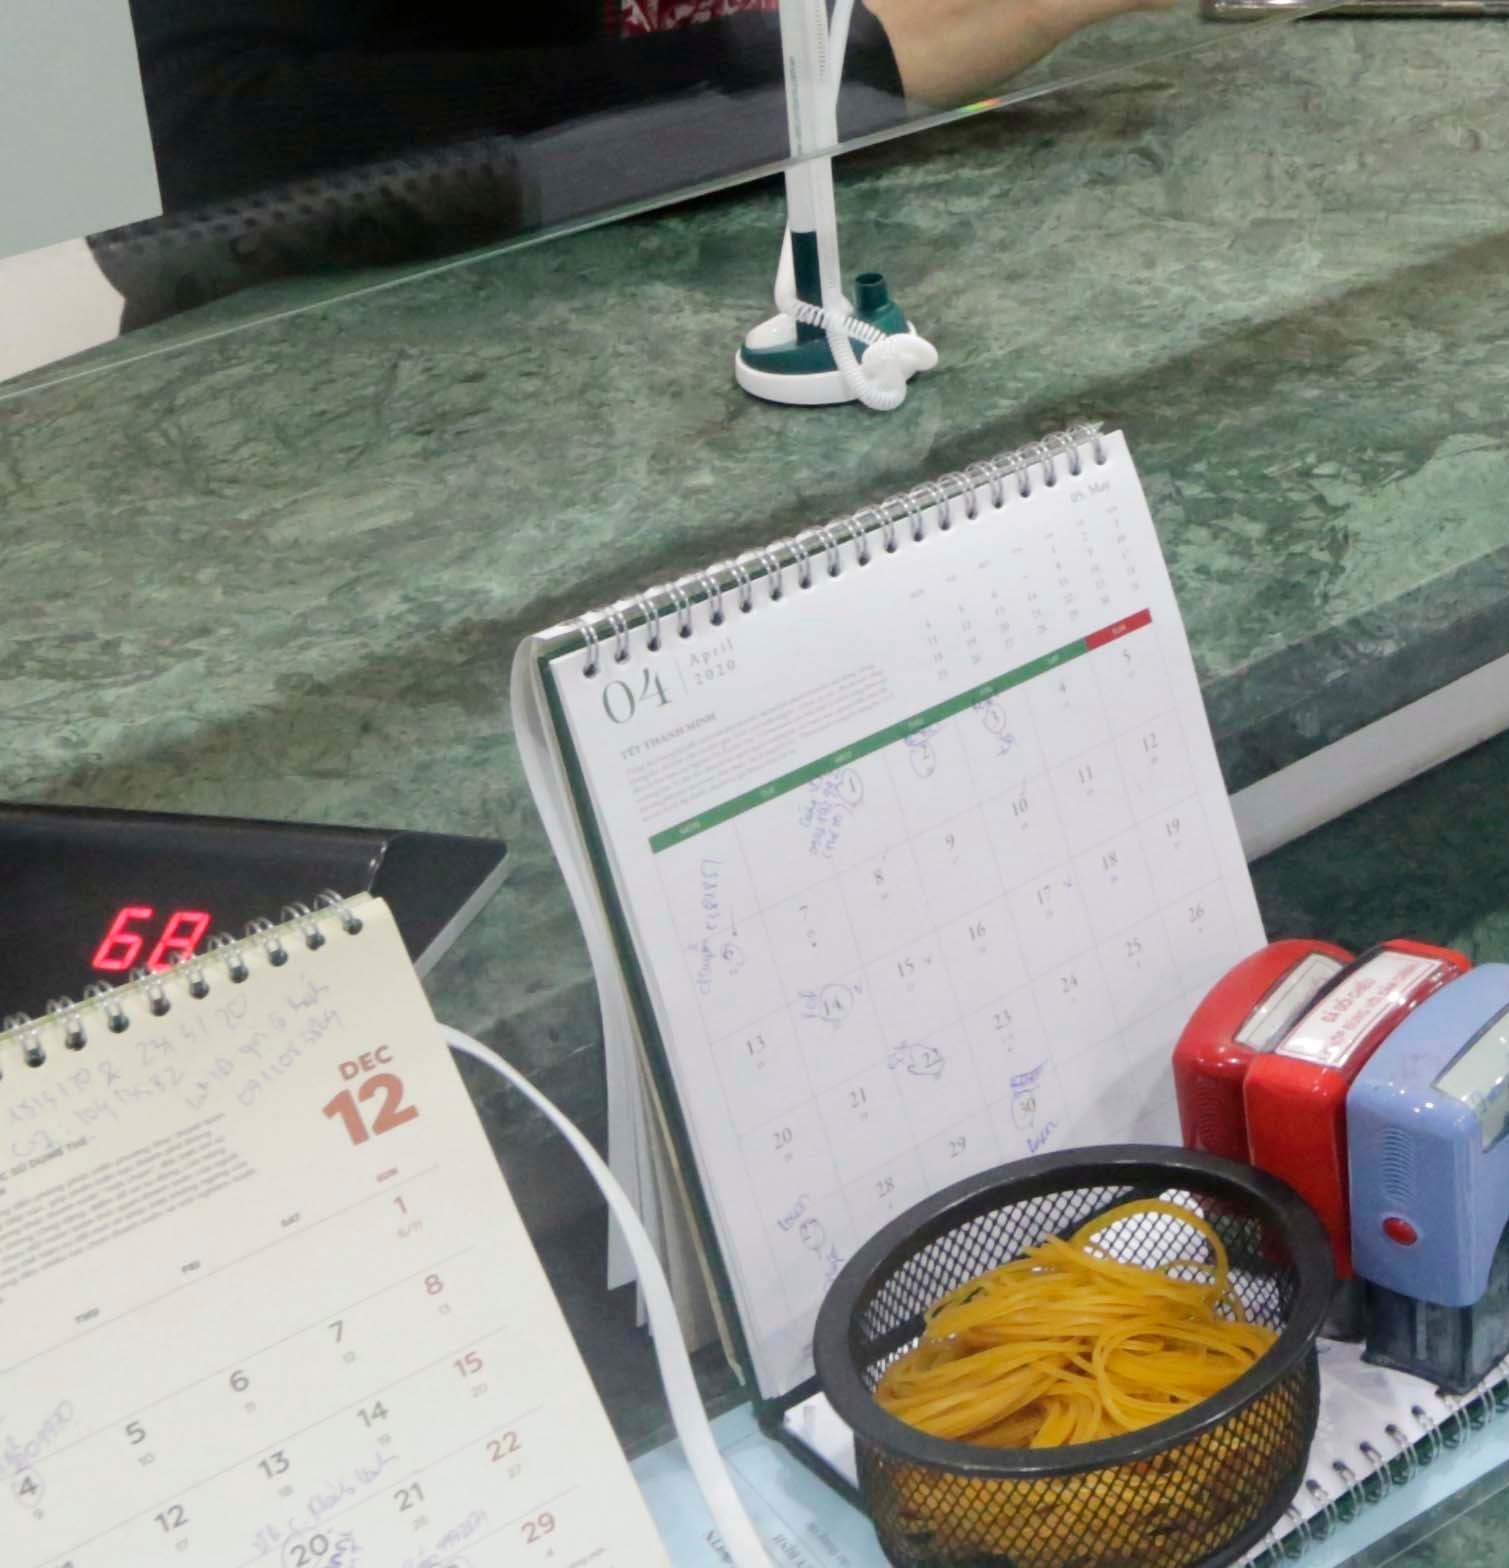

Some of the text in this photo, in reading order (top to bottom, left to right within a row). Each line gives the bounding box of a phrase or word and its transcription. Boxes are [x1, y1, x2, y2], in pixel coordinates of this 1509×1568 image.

[689, 636, 735, 667] April
[696, 659, 737, 686] 2020
[1122, 648, 1133, 663] 5
[602, 668, 672, 724] 04
[1011, 797, 1029, 817] 10
[1077, 765, 1094, 784] 11
[1141, 732, 1159, 753] 12
[92, 906, 212, 973] 68
[745, 1034, 766, 1056] 13
[897, 957, 915, 978] 15
[969, 920, 987, 941] 16
[1036, 885, 1051, 905] 17
[1101, 850, 1119, 871] 18
[1164, 817, 1181, 837] 19
[338, 1044, 394, 1082] DEC
[773, 1127, 793, 1151] 20
[849, 1087, 867, 1108] 21
[1124, 937, 1142, 957] 25
[321, 1072, 420, 1147] 12
[393, 1196, 408, 1215] 1
[875, 1177, 895, 1199] 28
[18, 1273, 443, 1497] 4 5 6 7 8
[153, 1350, 484, 1533] 12 13 14 15
[290, 1430, 522, 1568] 20 21 22
[520, 1511, 557, 1545] 29
